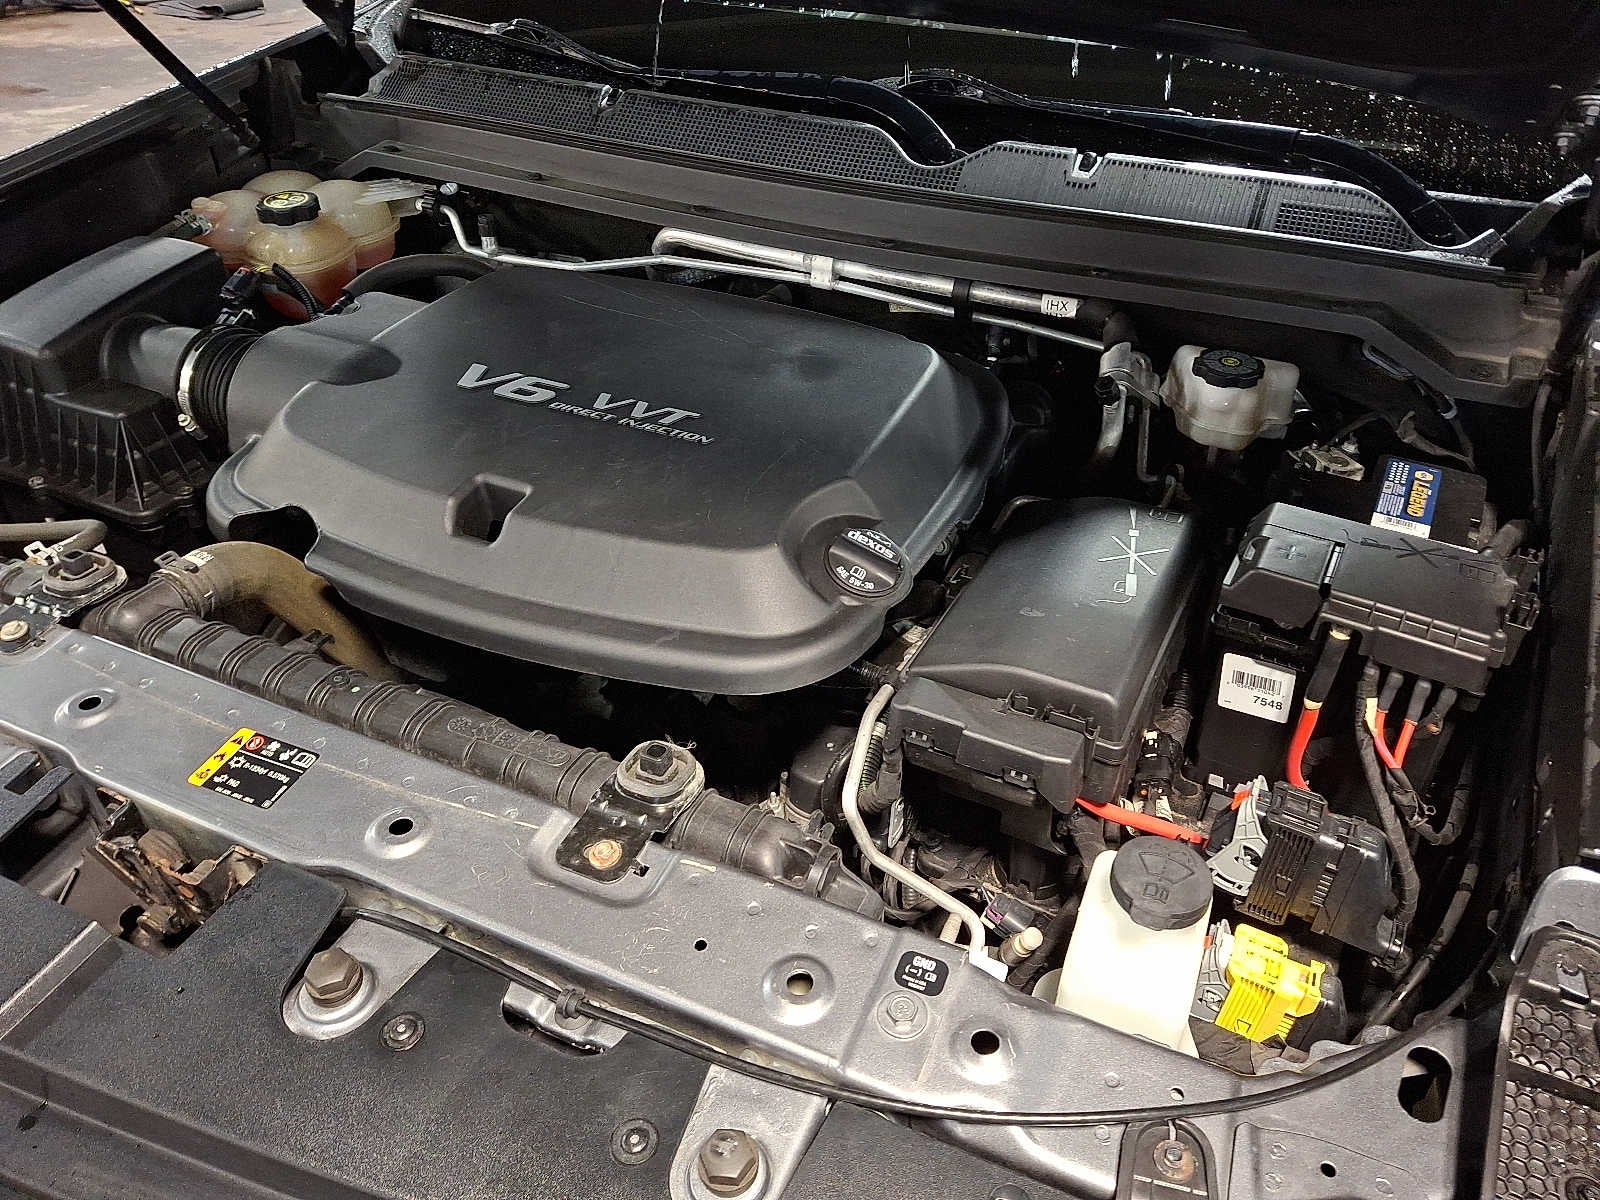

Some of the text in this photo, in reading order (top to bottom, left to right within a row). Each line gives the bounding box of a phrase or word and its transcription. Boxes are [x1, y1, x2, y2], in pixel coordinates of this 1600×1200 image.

[1046, 299, 1070, 312] IHX
[456, 363, 702, 425] V6 VVT
[548, 401, 715, 445] DIRECT INJECTION
[847, 530, 897, 560] dexos
[836, 565, 875, 590] SAE 5W-30
[1252, 695, 1283, 711] 7548
